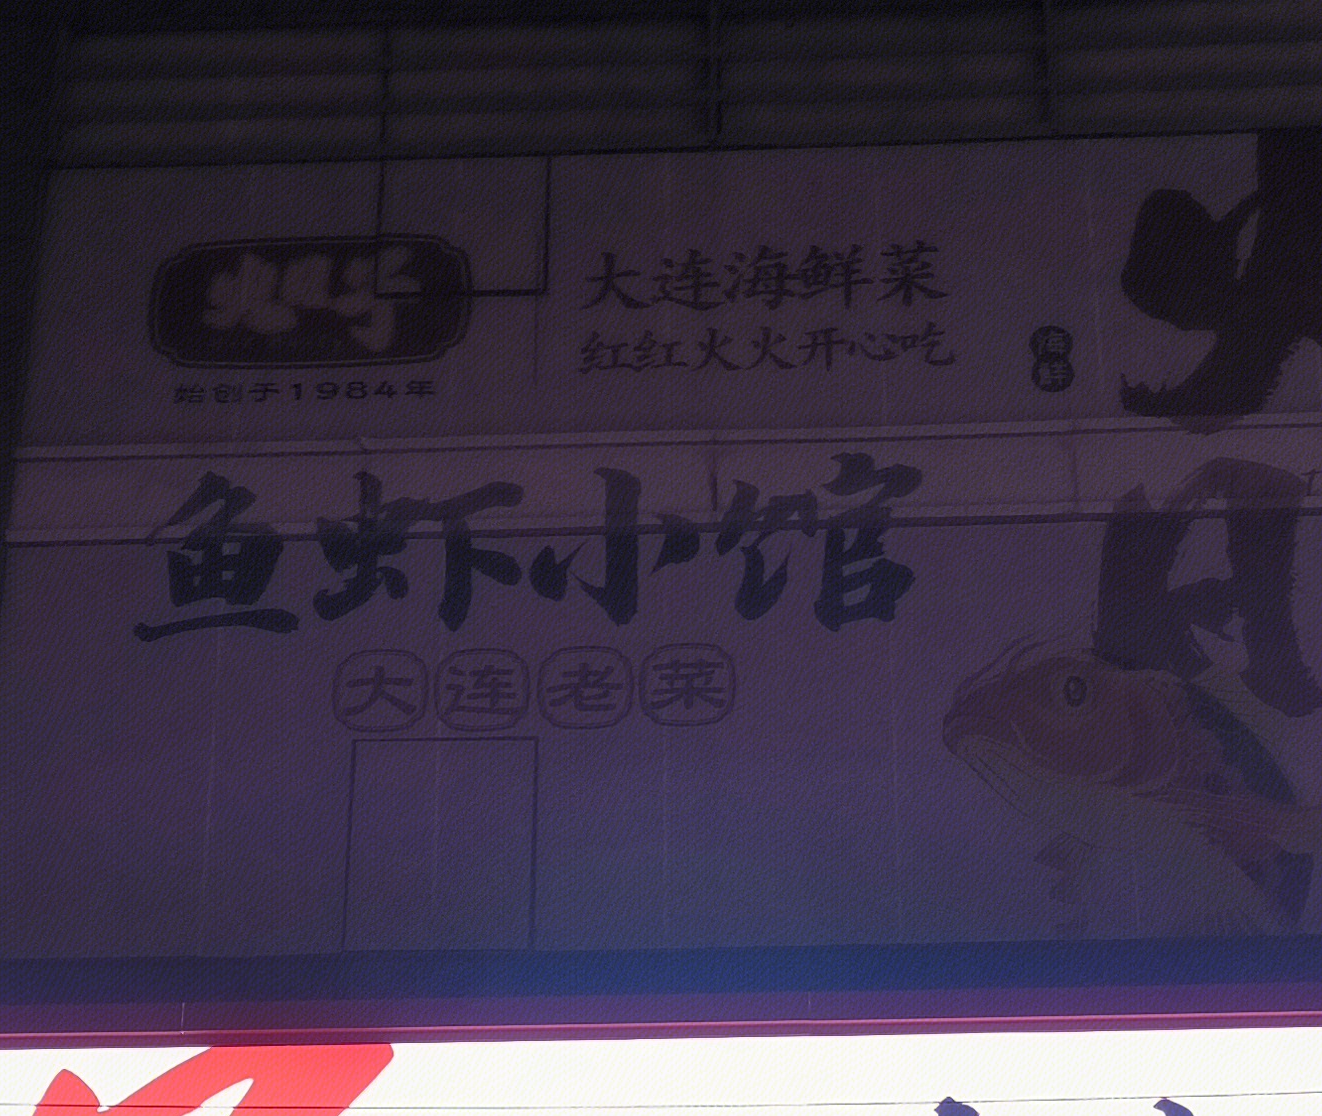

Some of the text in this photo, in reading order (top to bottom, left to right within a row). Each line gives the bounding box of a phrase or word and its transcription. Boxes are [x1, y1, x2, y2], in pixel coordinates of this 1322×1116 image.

[582, 240, 949, 312] 大连海鲜菜
[576, 322, 957, 374] 红红火火开心吃
[175, 380, 437, 403] 始创于1984年
[134, 452, 923, 642] 鱼虾小馆
[342, 656, 730, 718] 大连老菜
